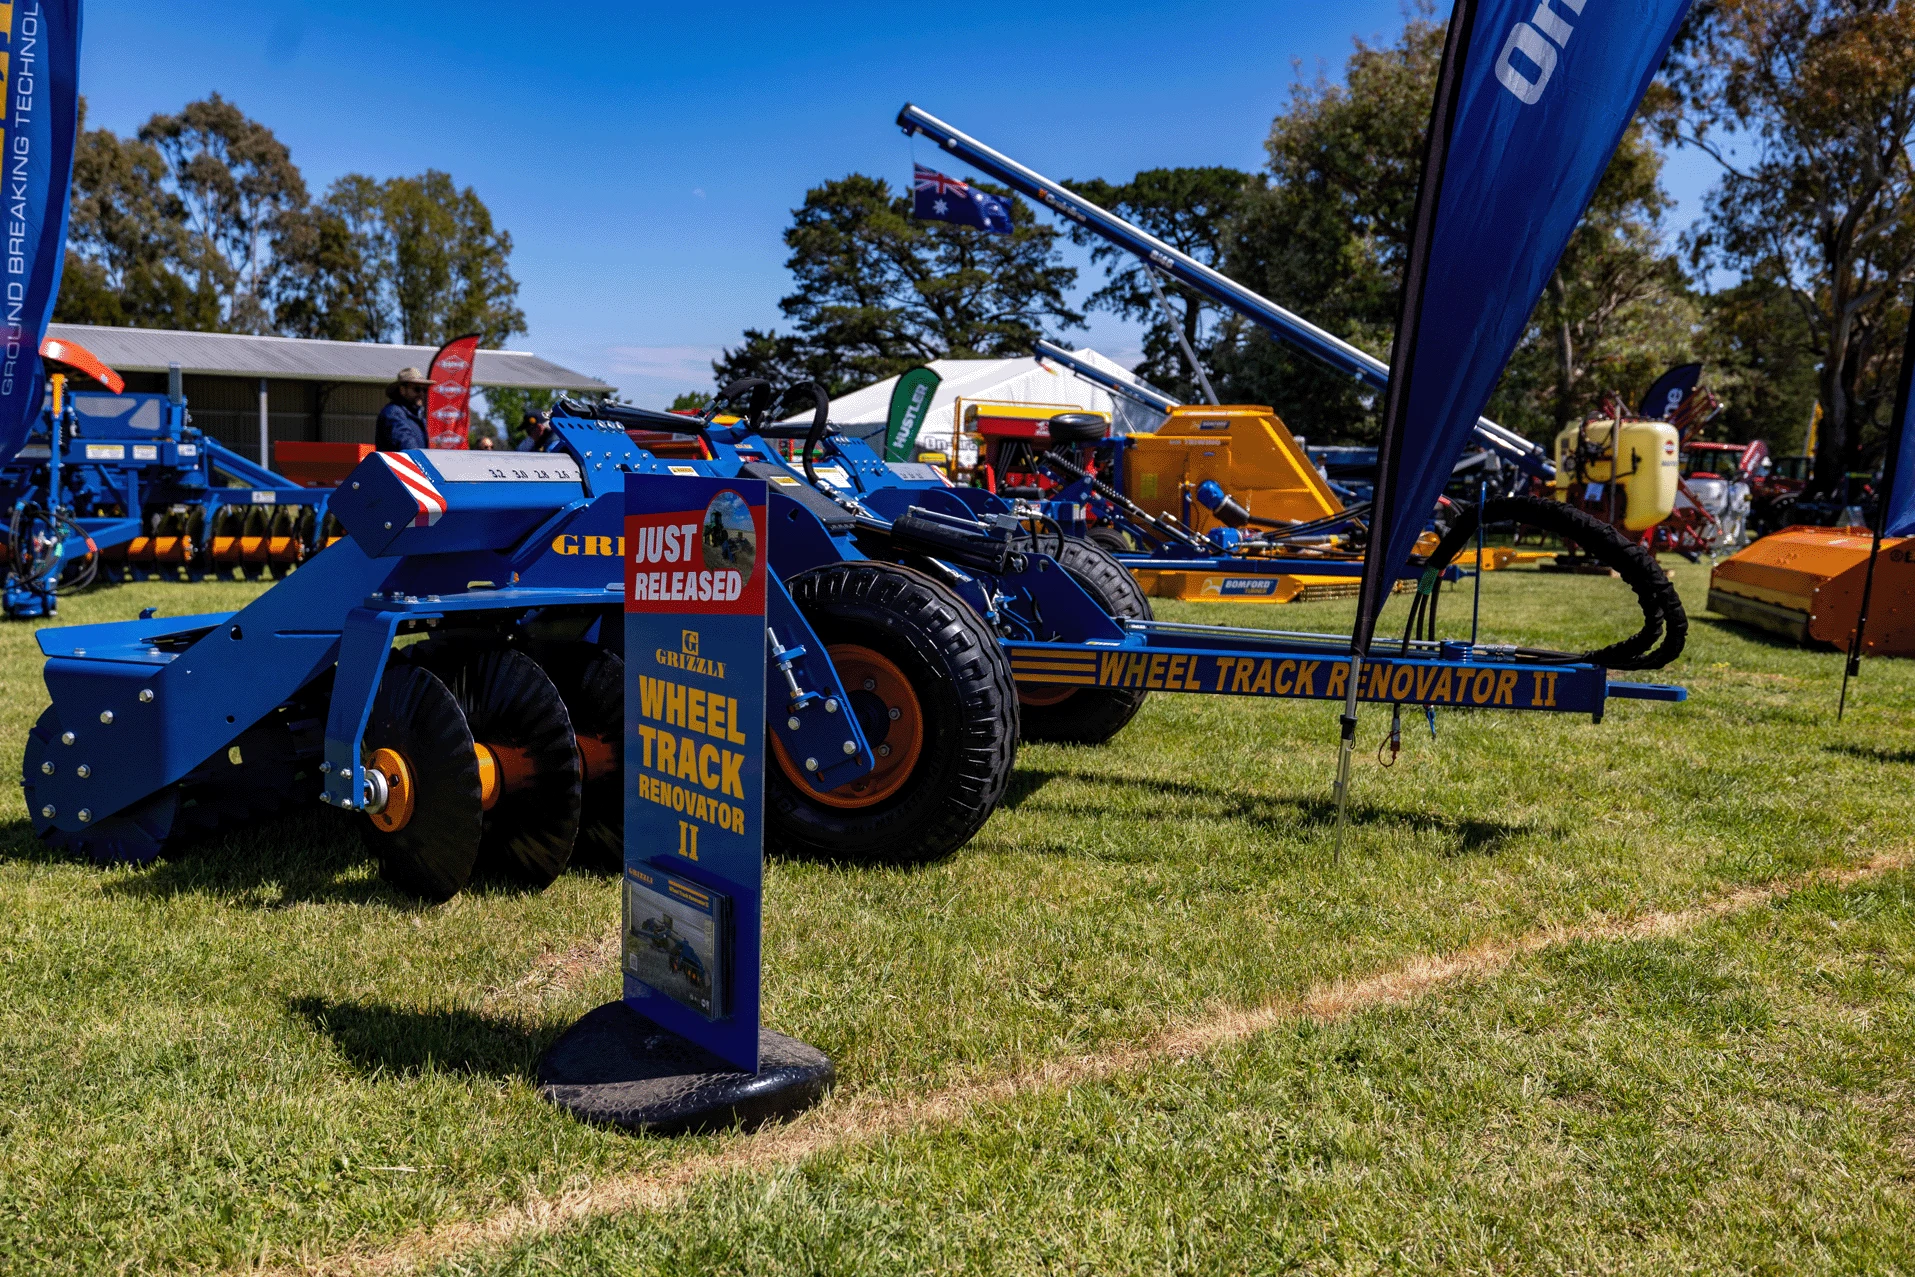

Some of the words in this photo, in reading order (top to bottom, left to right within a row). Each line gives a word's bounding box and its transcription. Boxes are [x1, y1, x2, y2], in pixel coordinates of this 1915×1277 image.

[15, 2, 39, 128] TECHNOL
[8, 136, 30, 274] BREAKING
[1, 282, 24, 396] GROUND
[892, 383, 929, 449] HUSTLER
[488, 469, 506, 479] 3.2
[512, 469, 529, 479] 3.0
[636, 524, 698, 564] JUST
[635, 570, 742, 601] RELEASED
[1225, 580, 1271, 588] BOMFORD
[655, 648, 727, 679] GRIZZLY
[1099, 652, 1201, 691] WHEEL
[1216, 656, 1301, 696] TRACK
[1326, 661, 1519, 706] RENOVATOR
[1531, 671, 1559, 707] II
[638, 674, 746, 746] WHEEL
[638, 724, 745, 800] TRACK
[638, 773, 745, 836] RENOVATOR
[678, 820, 699, 861] II
